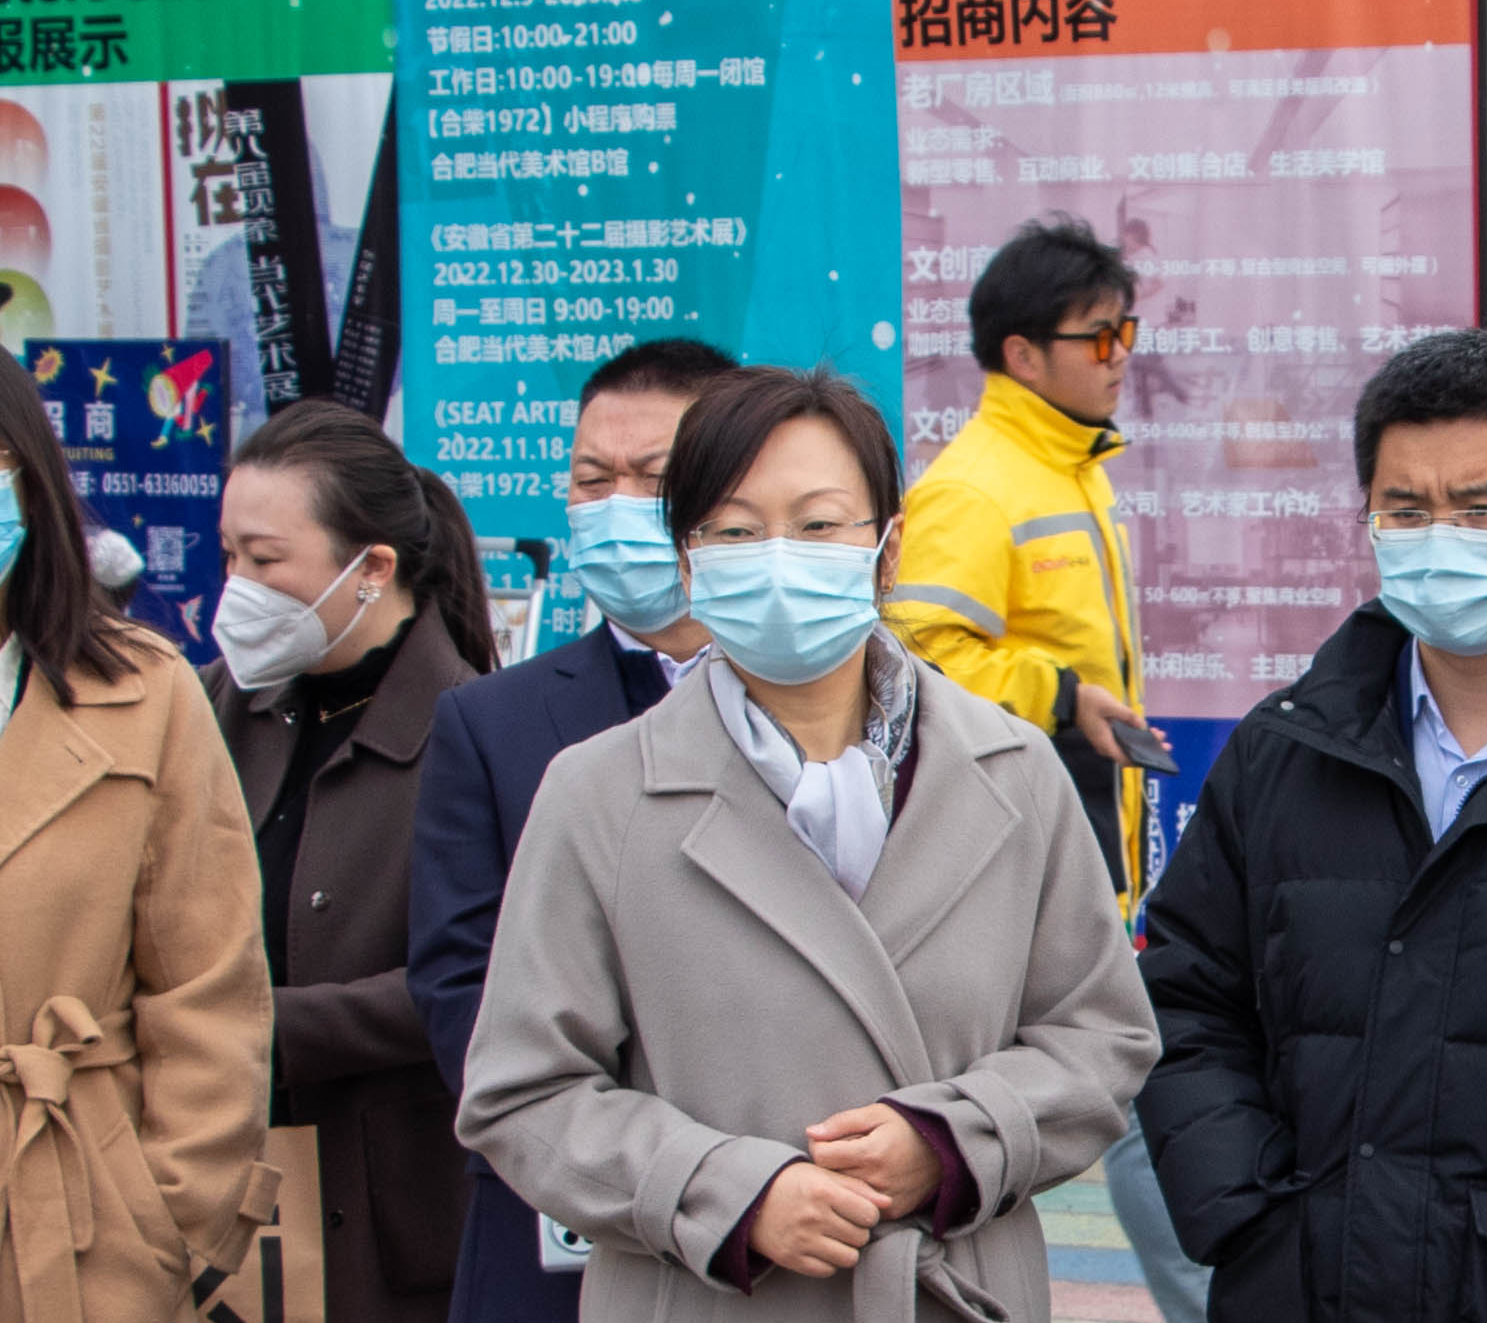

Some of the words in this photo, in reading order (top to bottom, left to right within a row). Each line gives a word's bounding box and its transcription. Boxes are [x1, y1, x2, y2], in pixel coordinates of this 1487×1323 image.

[903, 70, 1055, 110] 老厂房区域
[430, 148, 629, 181] 合肥当代美术馆B馆
[433, 259, 679, 286] 2022.12.30-2023.1.30
[432, 297, 547, 327] 周一至周日
[553, 295, 674, 324] 9:00-19:00
[102, 473, 220, 496] 0551-63360059
[1183, 489, 1320, 517] 艺术家工作坊
